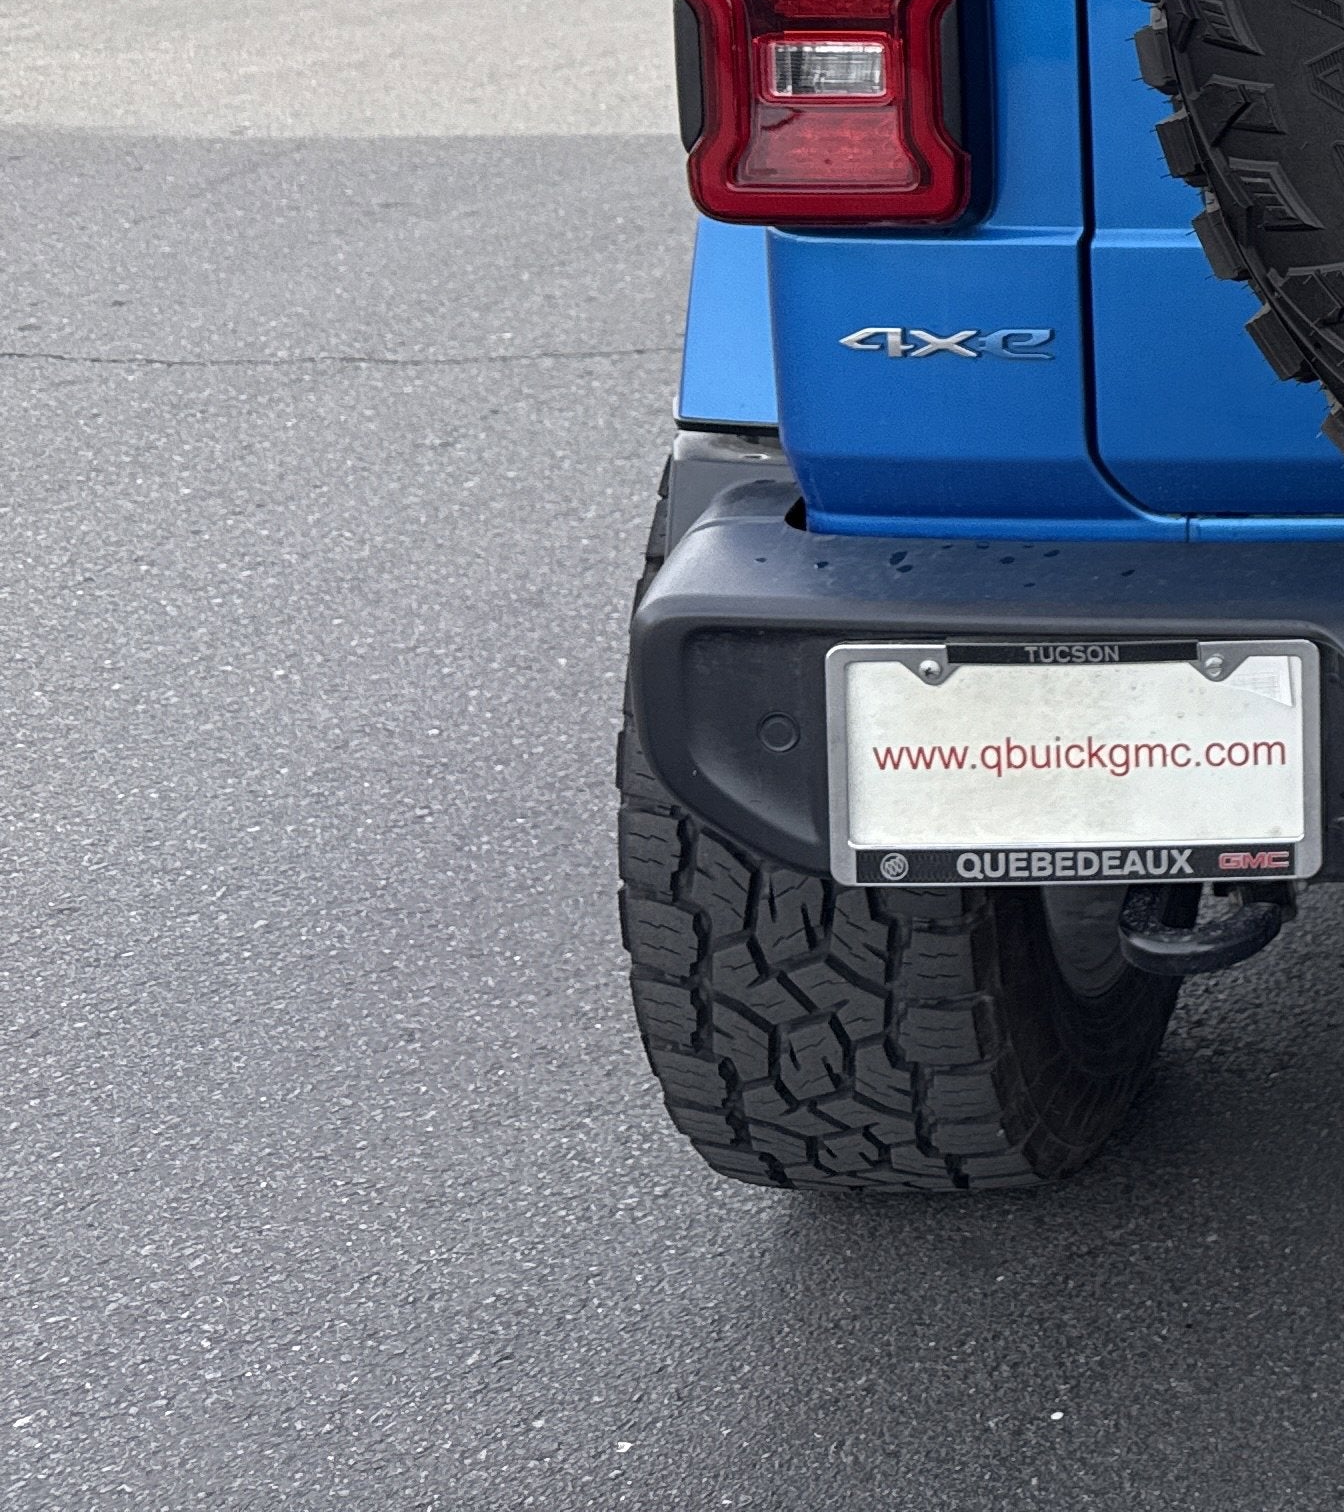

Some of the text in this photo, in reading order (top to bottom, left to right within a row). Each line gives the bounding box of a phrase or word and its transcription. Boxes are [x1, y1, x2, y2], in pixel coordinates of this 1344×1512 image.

[1024, 645, 1120, 663] TUCSON
[872, 736, 1287, 777] www.qbuickgmc.com
[955, 848, 1290, 880] QUEBEDEAUX GMC
